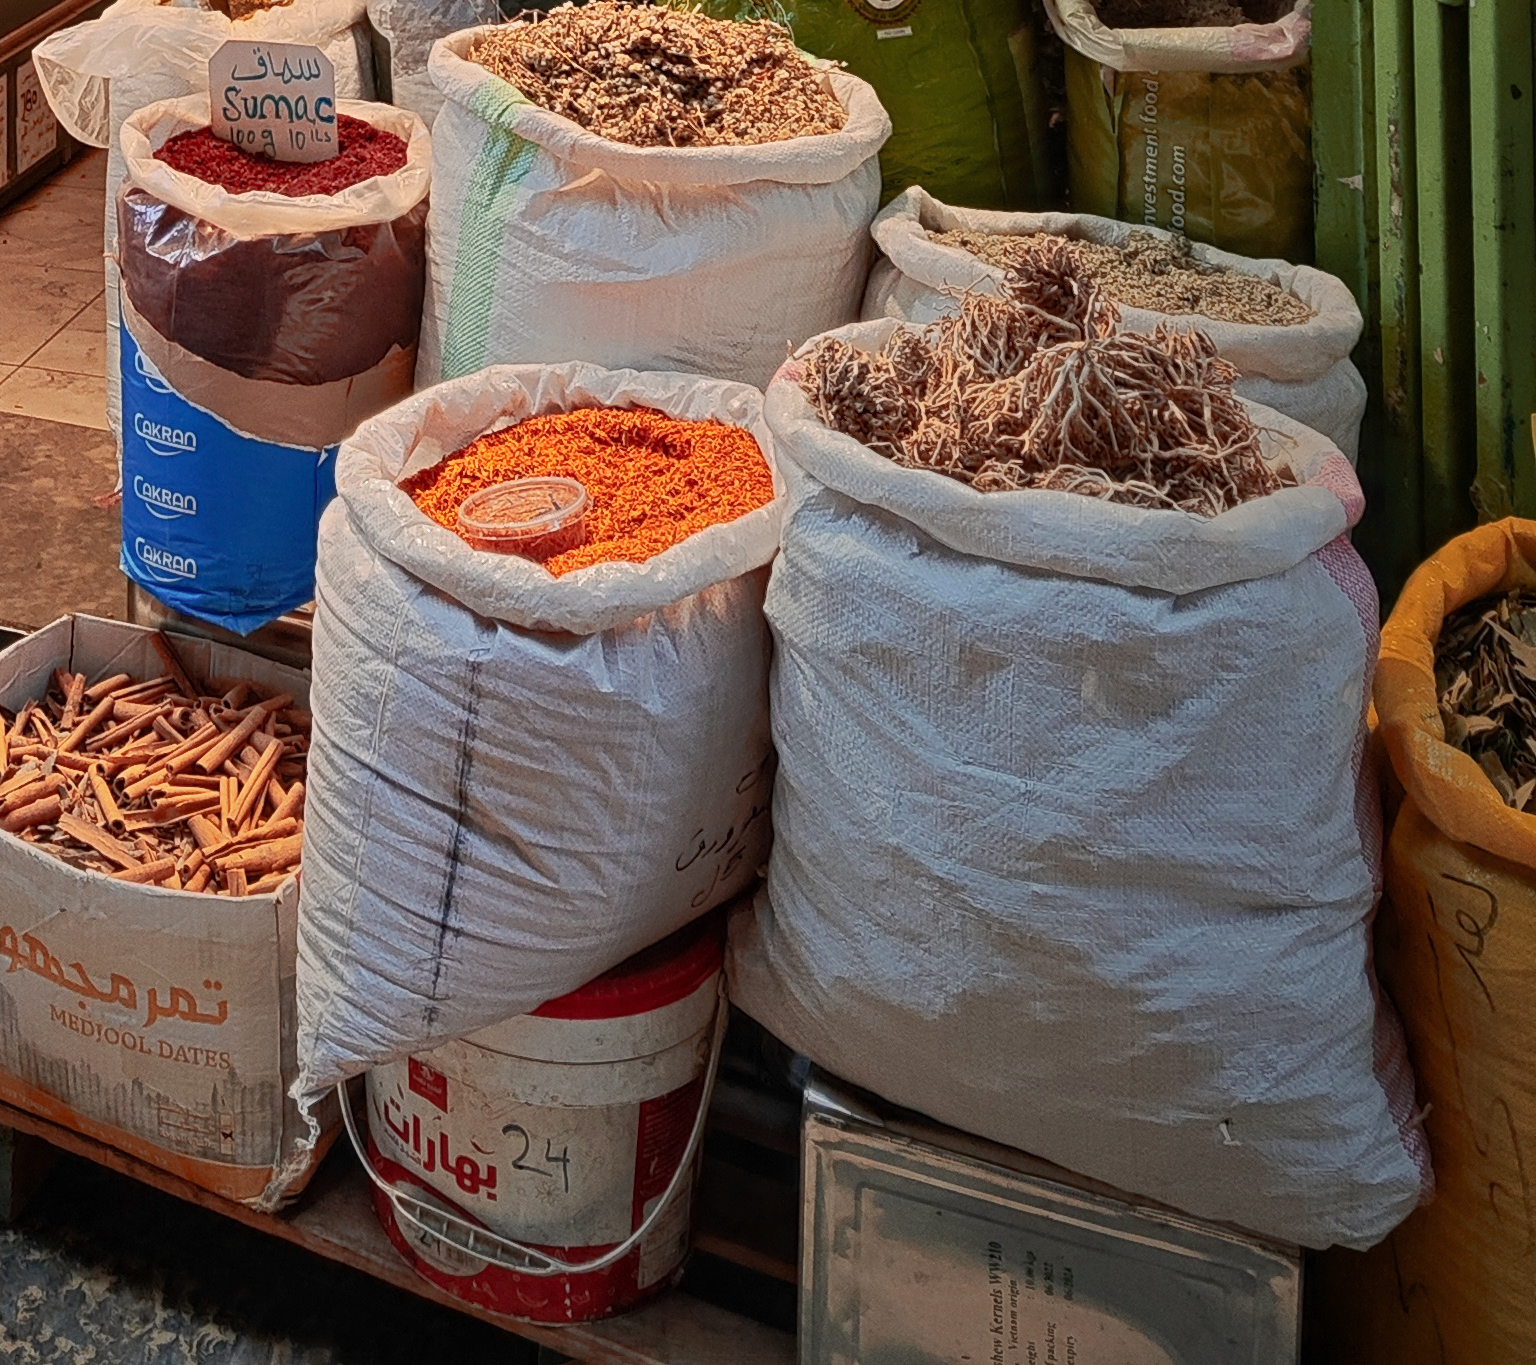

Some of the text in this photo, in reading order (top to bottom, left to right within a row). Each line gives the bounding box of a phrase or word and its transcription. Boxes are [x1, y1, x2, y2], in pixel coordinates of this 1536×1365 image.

[231, 47, 321, 84] سماق
[222, 86, 335, 125] Sumac
[230, 126, 255, 145] 100
[289, 128, 305, 150] 10
[1143, 123, 1158, 226] nvestment
[143, 979, 229, 1028] تمر
[49, 1004, 232, 1070] MEDJOOL DATES
[384, 1096, 497, 1202] بهارات
[502, 1124, 571, 1193] 24
[989, 1288, 1005, 1334] Kernels
